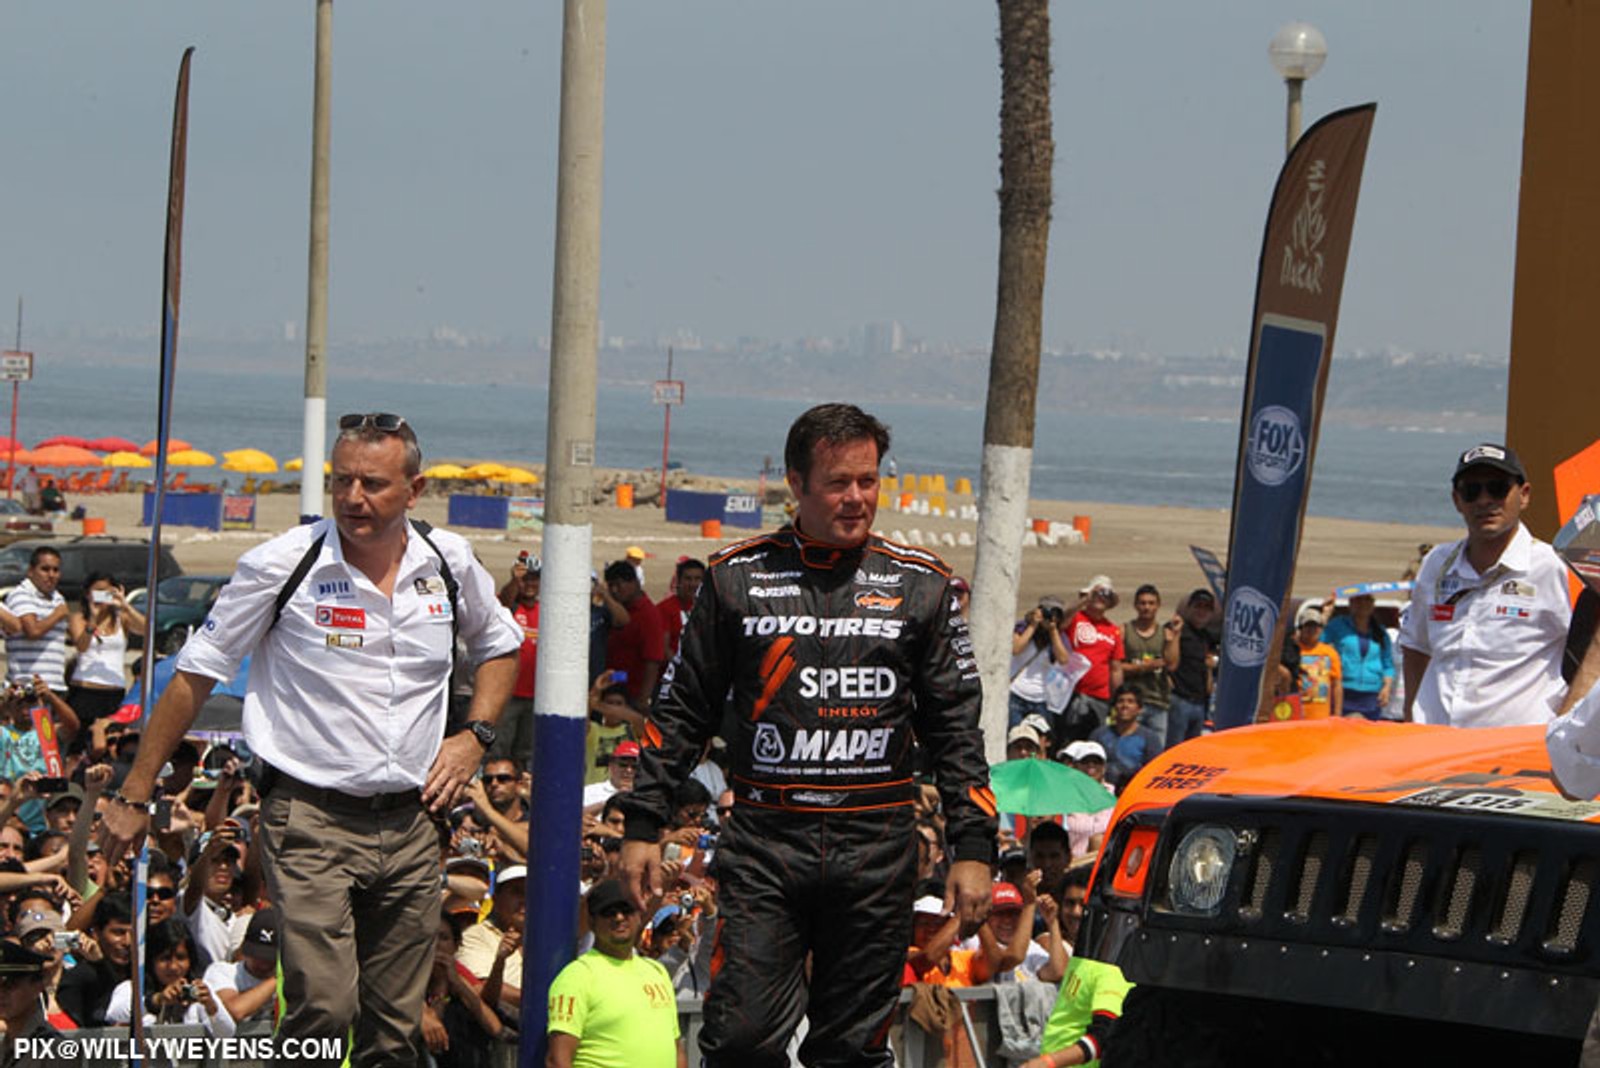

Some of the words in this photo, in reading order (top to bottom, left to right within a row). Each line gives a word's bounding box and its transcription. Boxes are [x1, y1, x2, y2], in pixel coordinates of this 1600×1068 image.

[1257, 420, 1293, 458] FOX
[1232, 600, 1266, 639] FOX
[1229, 631, 1266, 654] SPORTS
[798, 666, 897, 699] SPEED
[790, 728, 893, 761] MAPEI
[1143, 776, 1212, 790] TIRES
[1163, 763, 1229, 777] TOYO
[1455, 795, 1533, 811] 315
